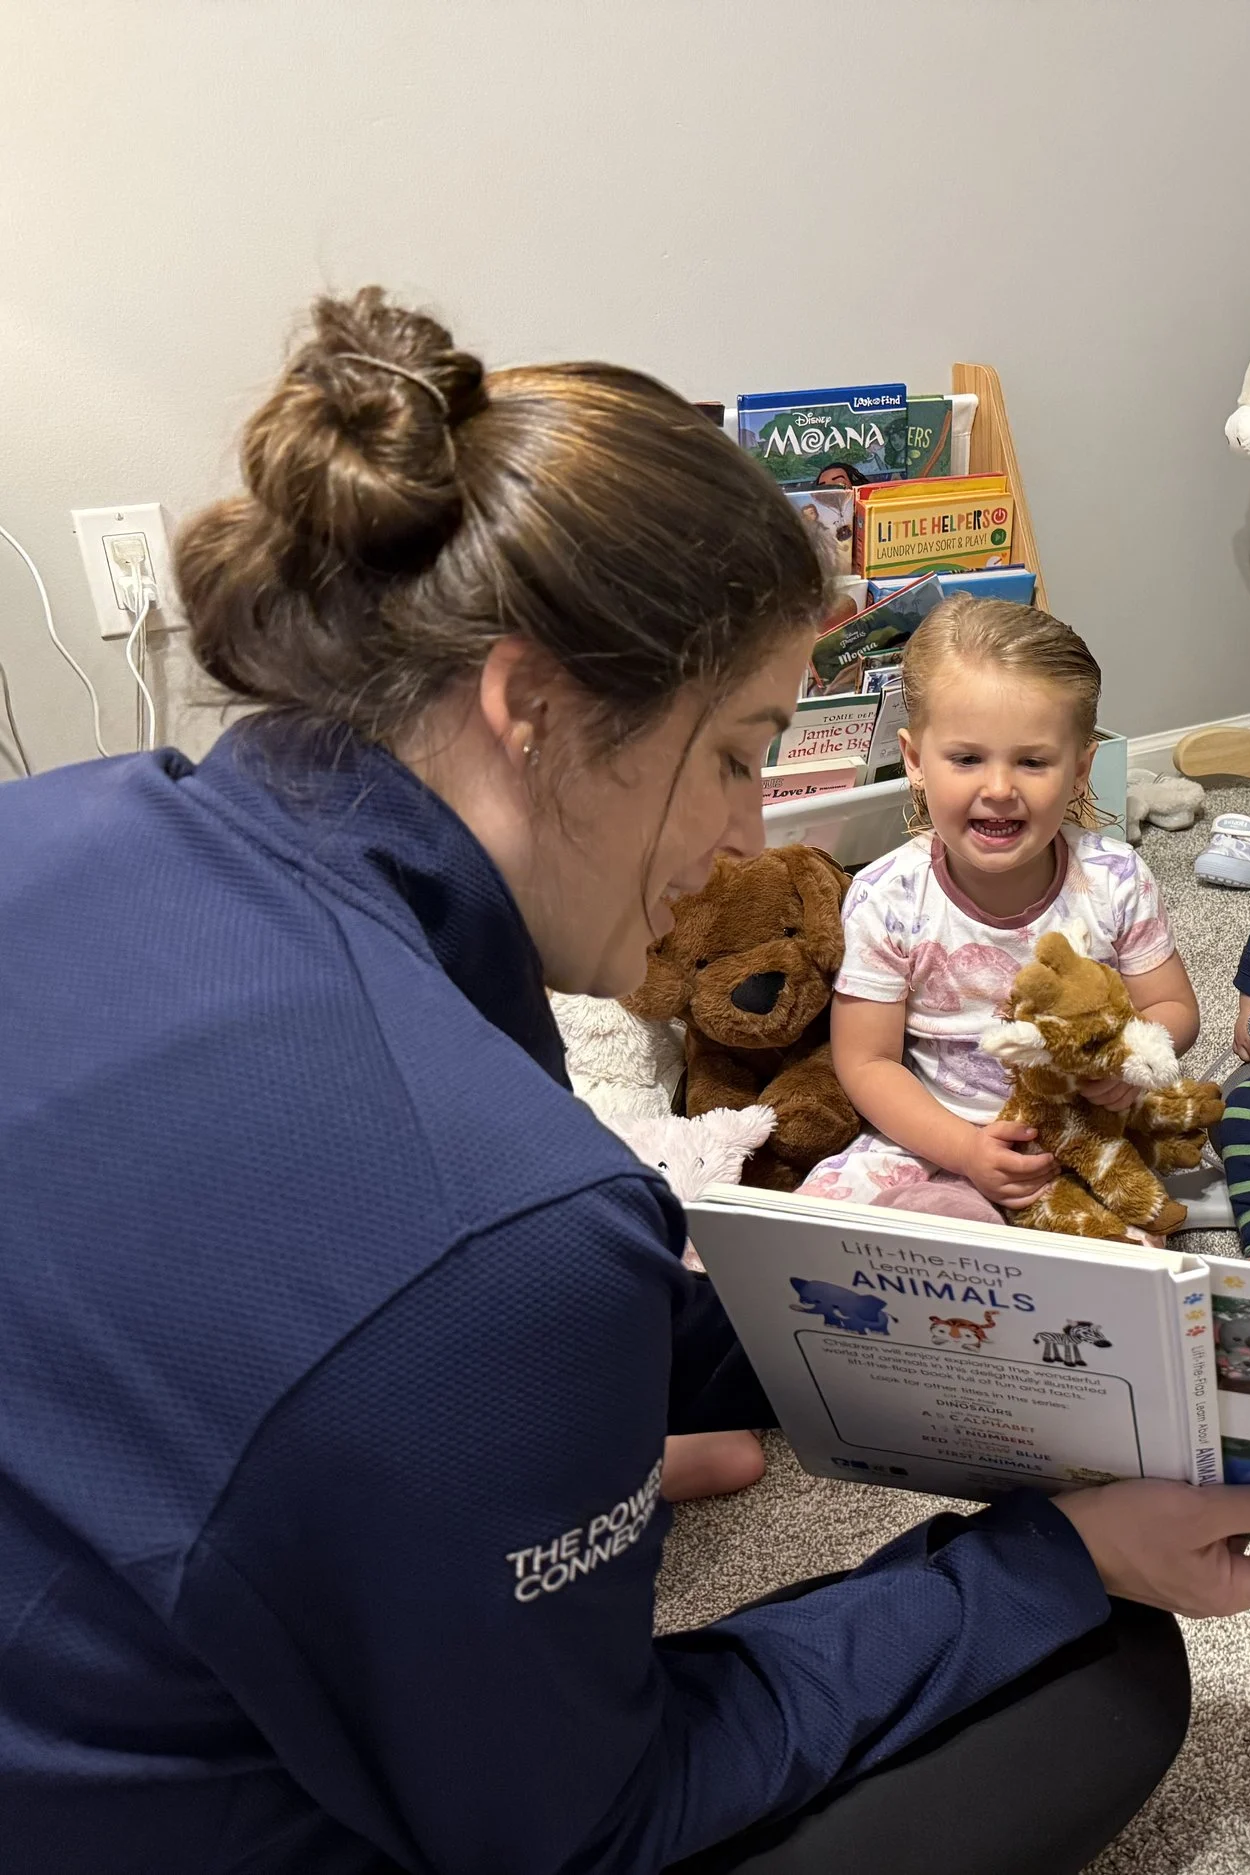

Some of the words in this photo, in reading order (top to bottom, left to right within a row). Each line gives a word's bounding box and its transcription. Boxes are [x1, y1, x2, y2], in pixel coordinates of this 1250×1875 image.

[764, 423, 885, 458] MOANA
[907, 426, 933, 448] ERS
[931, 509, 990, 535] HELPERS
[877, 544, 917, 560] LAUNDRY
[918, 542, 935, 555] DAY
[936, 540, 955, 552] SORT
[957, 538, 963, 548] &
[965, 533, 987, 548] PLAY!
[838, 642, 879, 665] Moana
[823, 714, 853, 722] TOMIE
[788, 742, 817, 759] and
[820, 739, 843, 754] the
[846, 738, 871, 752] Big
[798, 726, 842, 745] Jamie
[772, 788, 803, 798] Love
[805, 785, 817, 794] Is
[841, 1240, 1023, 1279] Lift-the-Flap
[869, 1260, 929, 1278] Learn
[937, 1270, 1003, 1288] About
[852, 1270, 1036, 1313] ANIMALS
[945, 1356, 1005, 1372] exploring
[1008, 1366, 1030, 1374] the
[1034, 1369, 1102, 1386] wonderful
[946, 1364, 967, 1374] this
[1044, 1379, 1107, 1395] illustrated
[995, 1380, 1016, 1389] fun
[1019, 1384, 1046, 1394] and
[936, 1399, 1013, 1417] DINOSAURS
[506, 1528, 583, 1578] THE
